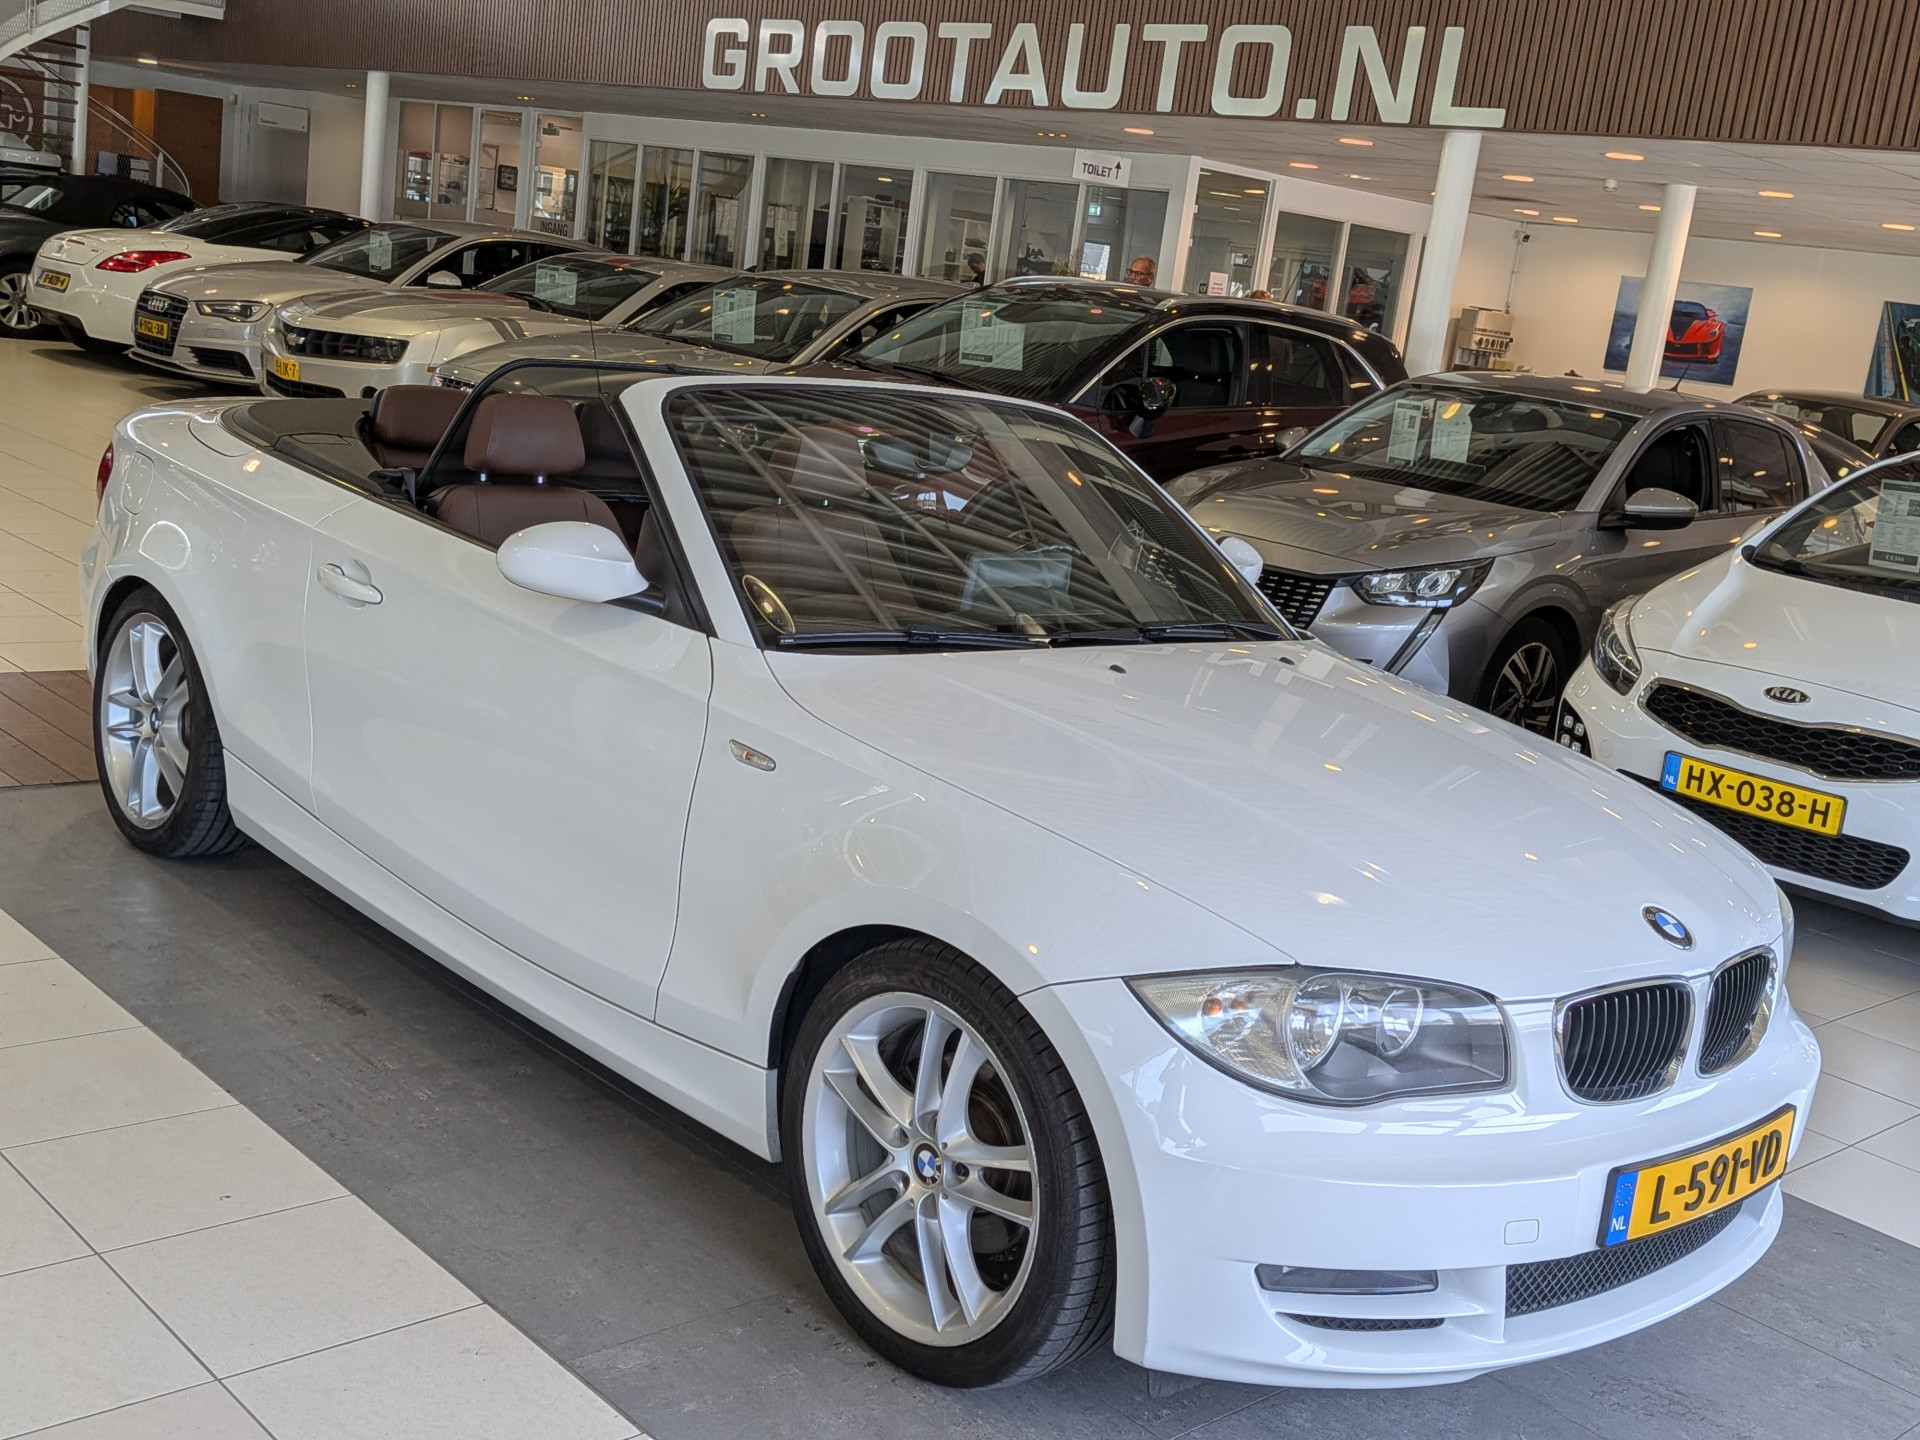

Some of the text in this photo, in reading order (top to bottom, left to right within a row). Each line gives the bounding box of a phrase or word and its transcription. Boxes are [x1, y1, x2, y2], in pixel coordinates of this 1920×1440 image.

[702, 18, 1506, 128] GROOTAUTO.NL
[1082, 162, 1112, 178] TOILET
[540, 221, 568, 237] INGANG
[1770, 687, 1801, 702] KIA
[1664, 774, 1676, 785] NL
[1686, 764, 1832, 828] HX-038-H
[1649, 1129, 1783, 1224] L-591-VD
[1610, 1215, 1626, 1232] NL
